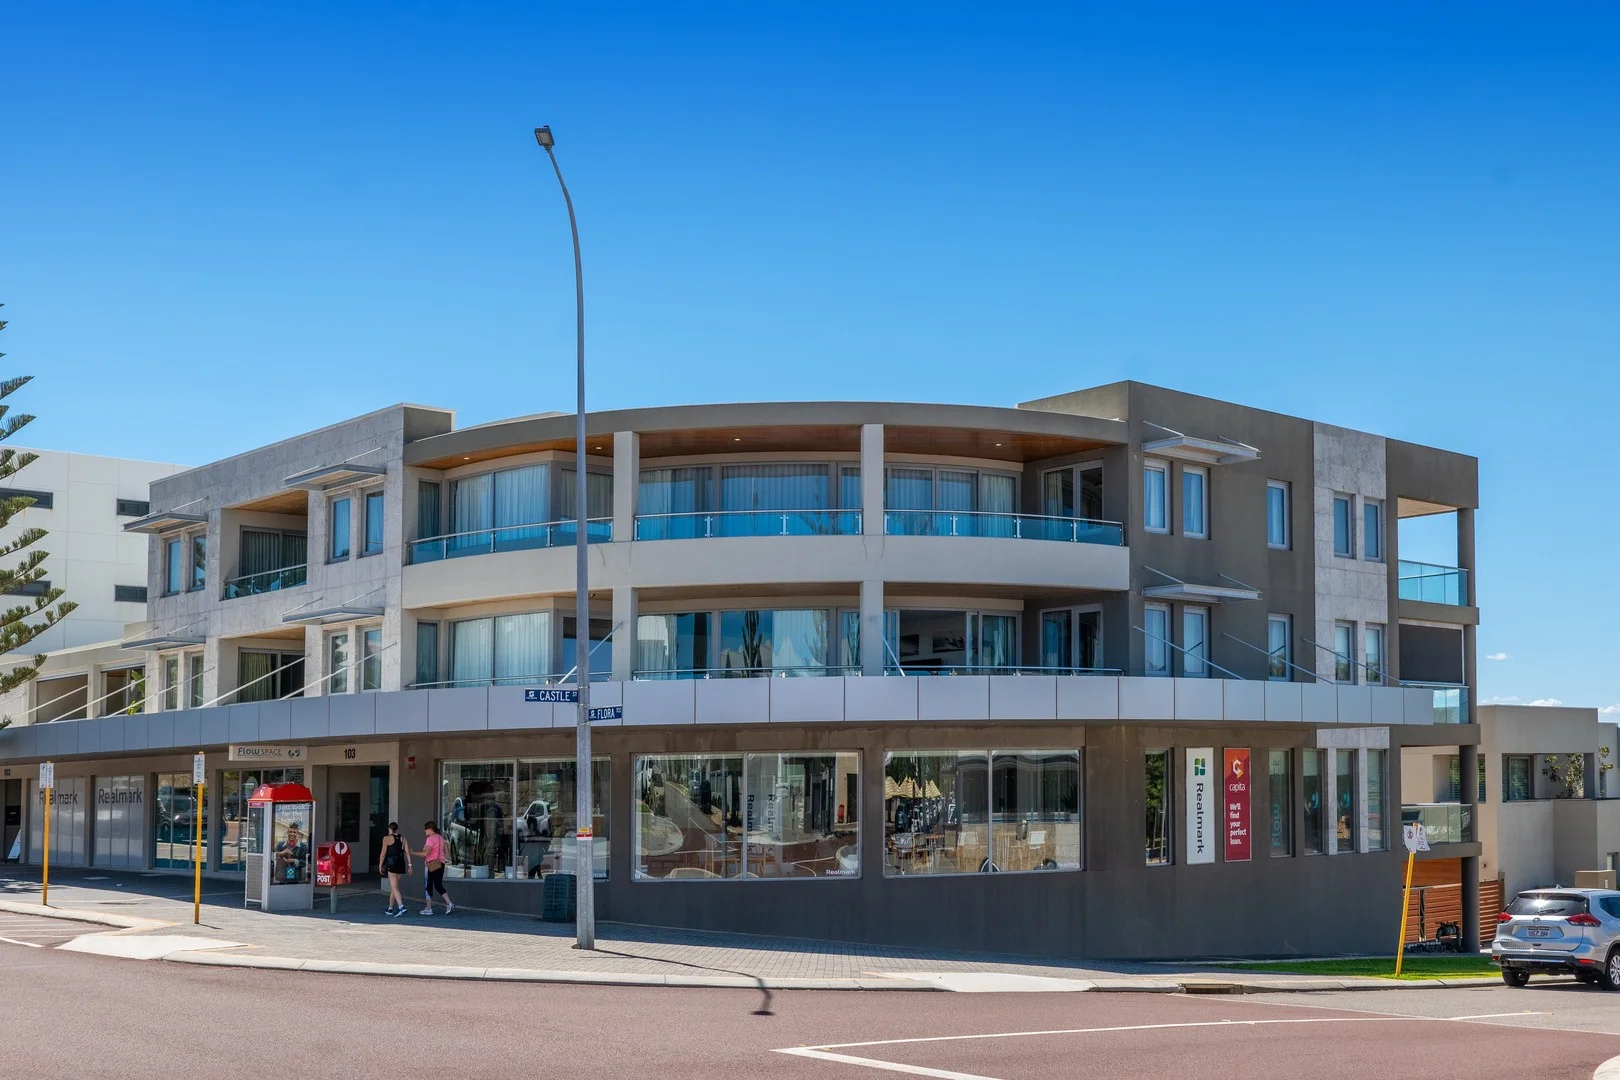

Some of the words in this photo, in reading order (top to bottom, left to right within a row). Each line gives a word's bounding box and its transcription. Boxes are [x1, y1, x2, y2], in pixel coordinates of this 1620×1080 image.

[539, 690, 570, 701] CASTLE
[597, 707, 615, 719] FLORA
[344, 748, 356, 760] 103
[1229, 782, 1246, 792] capita
[39, 790, 78, 805] Ralmark
[98, 787, 142, 804] Realmark
[1195, 783, 1205, 854] Realmark
[1229, 811, 1240, 819] find
[747, 794, 755, 854] Realmk
[1229, 821, 1241, 829] your
[1229, 828, 1247, 837] perfect
[317, 874, 331, 882] POST
